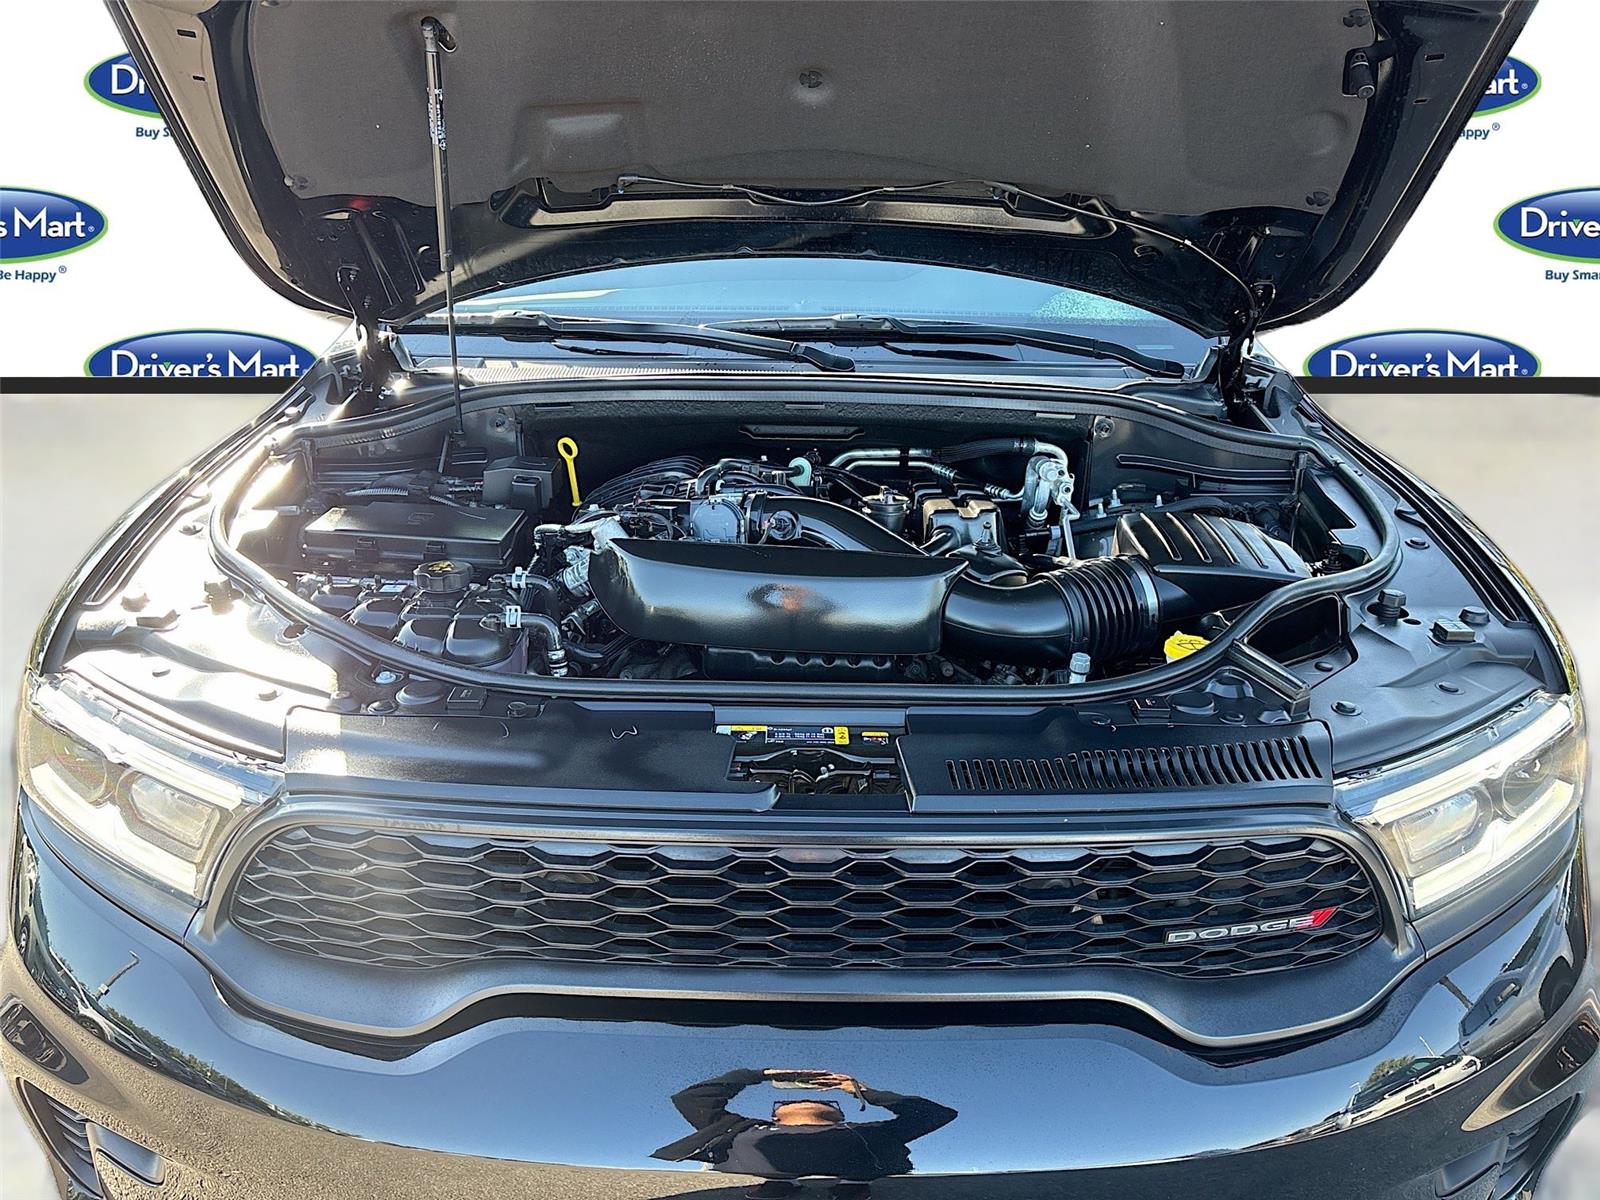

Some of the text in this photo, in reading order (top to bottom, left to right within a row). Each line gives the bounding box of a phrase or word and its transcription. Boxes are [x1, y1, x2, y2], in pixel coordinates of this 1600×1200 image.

[136, 126, 160, 140] Buy
[14, 206, 86, 238] Mart
[15, 269, 57, 283] Happy
[1545, 269, 1570, 283] Buy
[111, 349, 300, 377] Driver's Mart
[1330, 349, 1519, 377] Driver's Mart
[1167, 915, 1315, 943] DODGE
